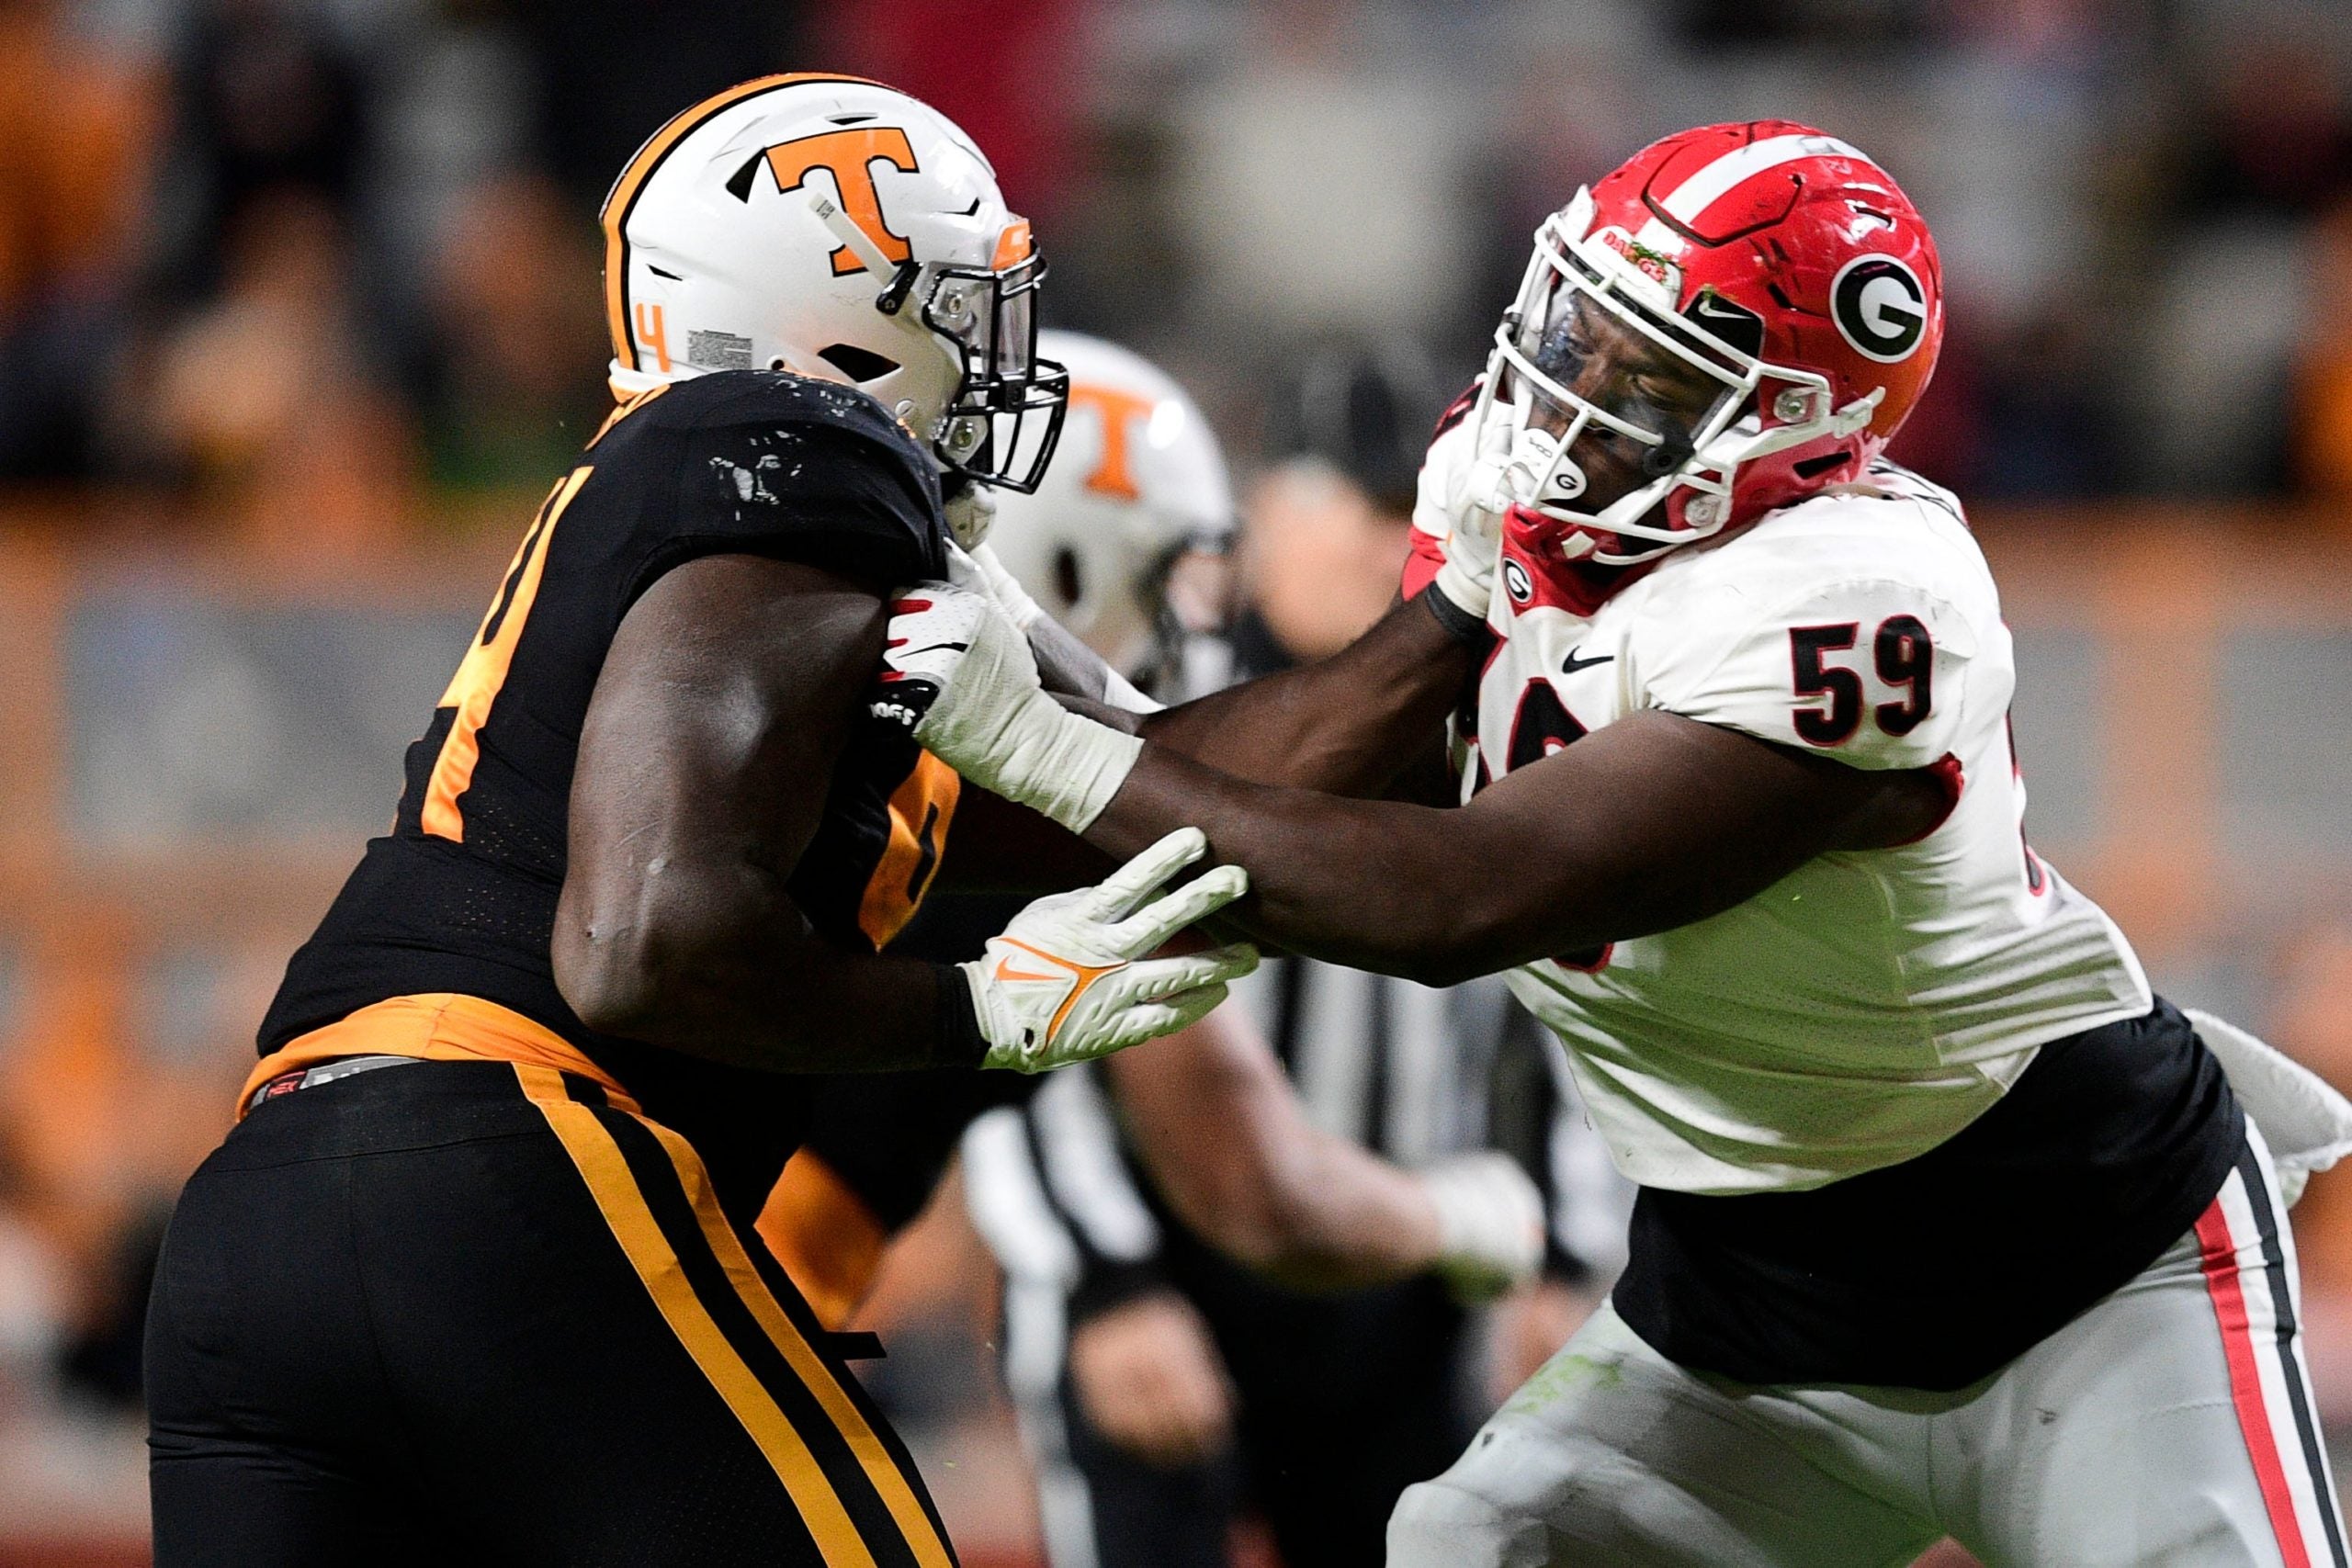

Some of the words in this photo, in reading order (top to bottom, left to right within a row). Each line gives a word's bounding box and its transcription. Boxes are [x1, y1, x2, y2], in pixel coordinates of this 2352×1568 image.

[765, 127, 920, 276] T
[636, 303, 672, 373] 4
[1836, 260, 1924, 356] G
[1556, 473, 1578, 491] G
[1505, 559, 1531, 601] G
[1790, 615, 1933, 747] 59
